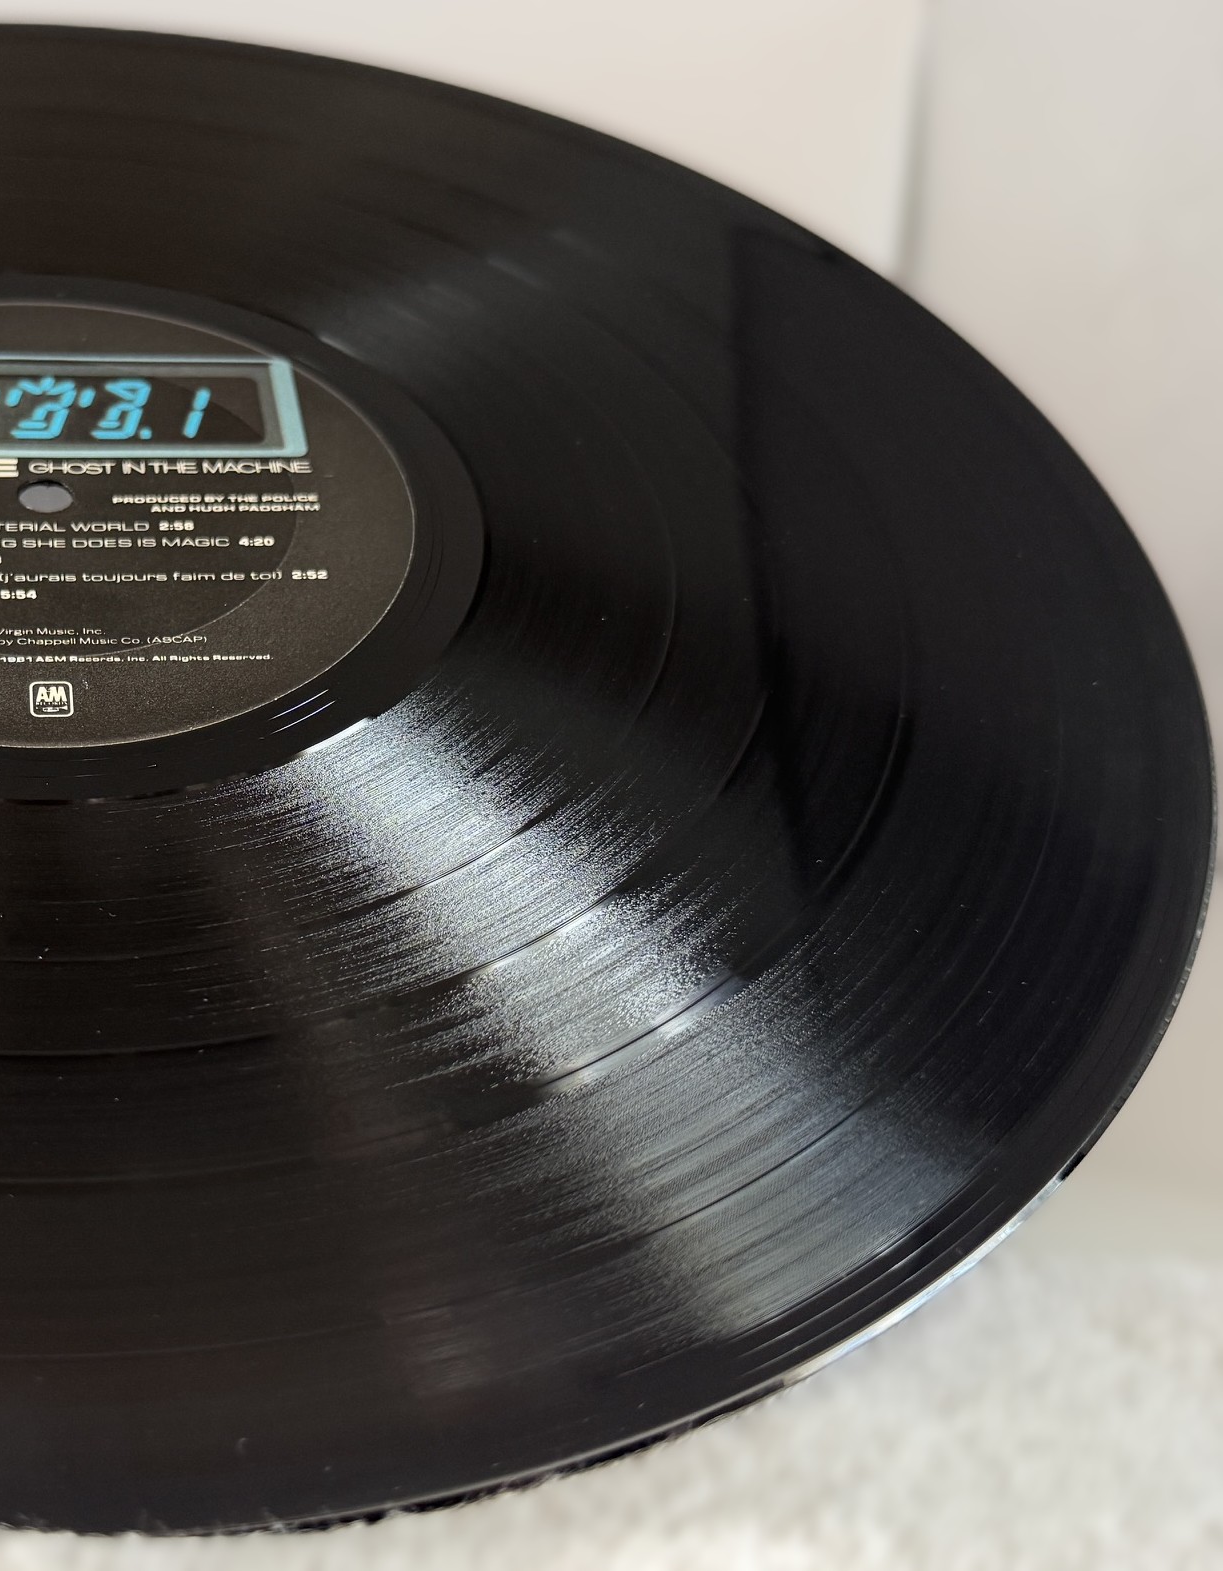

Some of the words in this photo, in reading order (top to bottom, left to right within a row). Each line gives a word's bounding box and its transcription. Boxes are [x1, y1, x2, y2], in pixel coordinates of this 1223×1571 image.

[28, 459, 116, 475] GHOST
[121, 459, 146, 475] IN
[148, 459, 199, 474] THE
[202, 459, 313, 474] MACHINE
[112, 493, 201, 504] PRODUCED
[204, 493, 226, 503] BY
[228, 493, 258, 503] THE
[261, 492, 319, 503] POLICE
[151, 504, 186, 513] AND
[189, 503, 236, 513] HUGH
[238, 502, 320, 512] PADGHAM
[70, 521, 150, 532] WORLD
[159, 520, 194, 531] 2:58
[22, 538, 66, 549] SHE
[72, 537, 132, 548] DOES
[137, 537, 156, 548] IS
[161, 536, 230, 548] MAGIC
[238, 535, 275, 547] 4:20
[82, 571, 167, 584] toujours
[173, 571, 216, 582] faim
[220, 571, 245, 581] de
[291, 569, 329, 580] 2:52
[0, 589, 38, 600] 5:54
[36, 628, 79, 636] Music,
[82, 627, 106, 635] Inc.
[16, 637, 76, 647] Chappell
[79, 637, 118, 645] Music
[121, 637, 144, 645] Co.
[146, 635, 208, 645] (ASCAP)
[0, 656, 33, 664] 1981
[36, 655, 67, 663] A&M
[127, 655, 149, 663] Inc.
[152, 655, 167, 663] All
[170, 655, 210, 664] Rights
[212, 653, 274, 662] Reserved.
